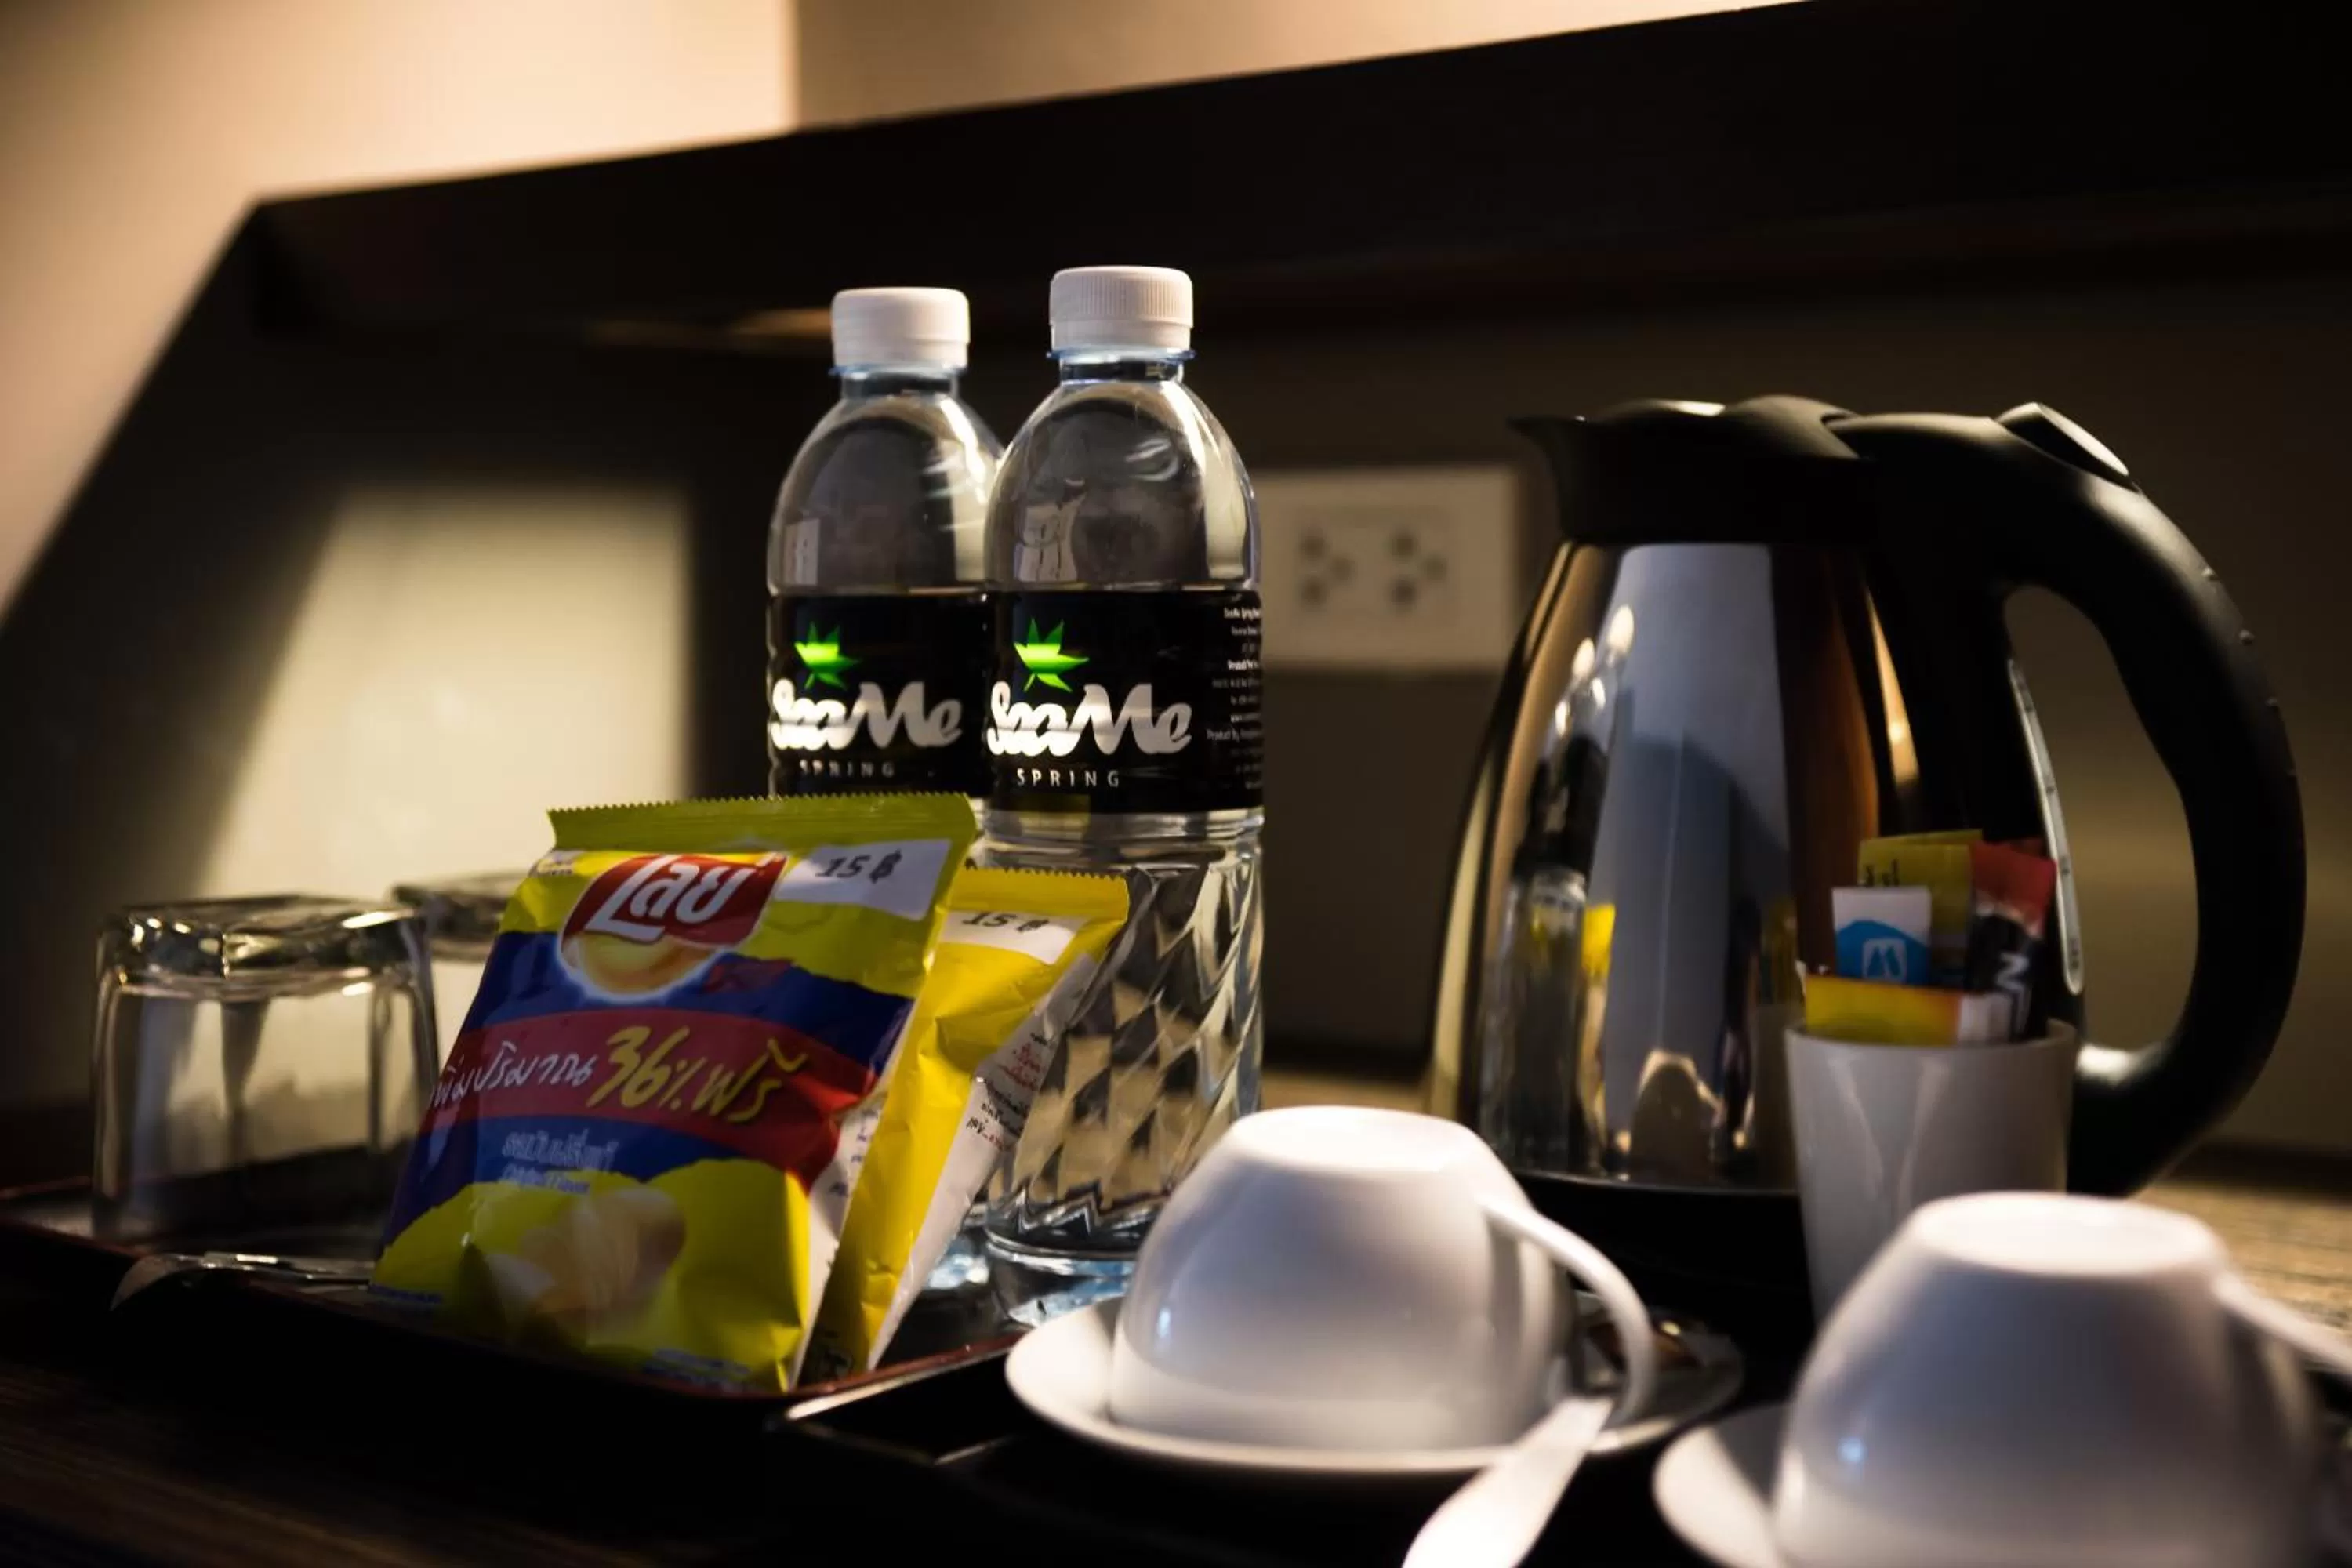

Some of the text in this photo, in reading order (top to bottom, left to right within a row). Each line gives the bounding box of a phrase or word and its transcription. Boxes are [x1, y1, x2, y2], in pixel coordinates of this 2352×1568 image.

[799, 759, 895, 778] SPRING
[1016, 768, 1120, 788] SPRING
[815, 855, 871, 879] 15
[961, 910, 1018, 928] 15
